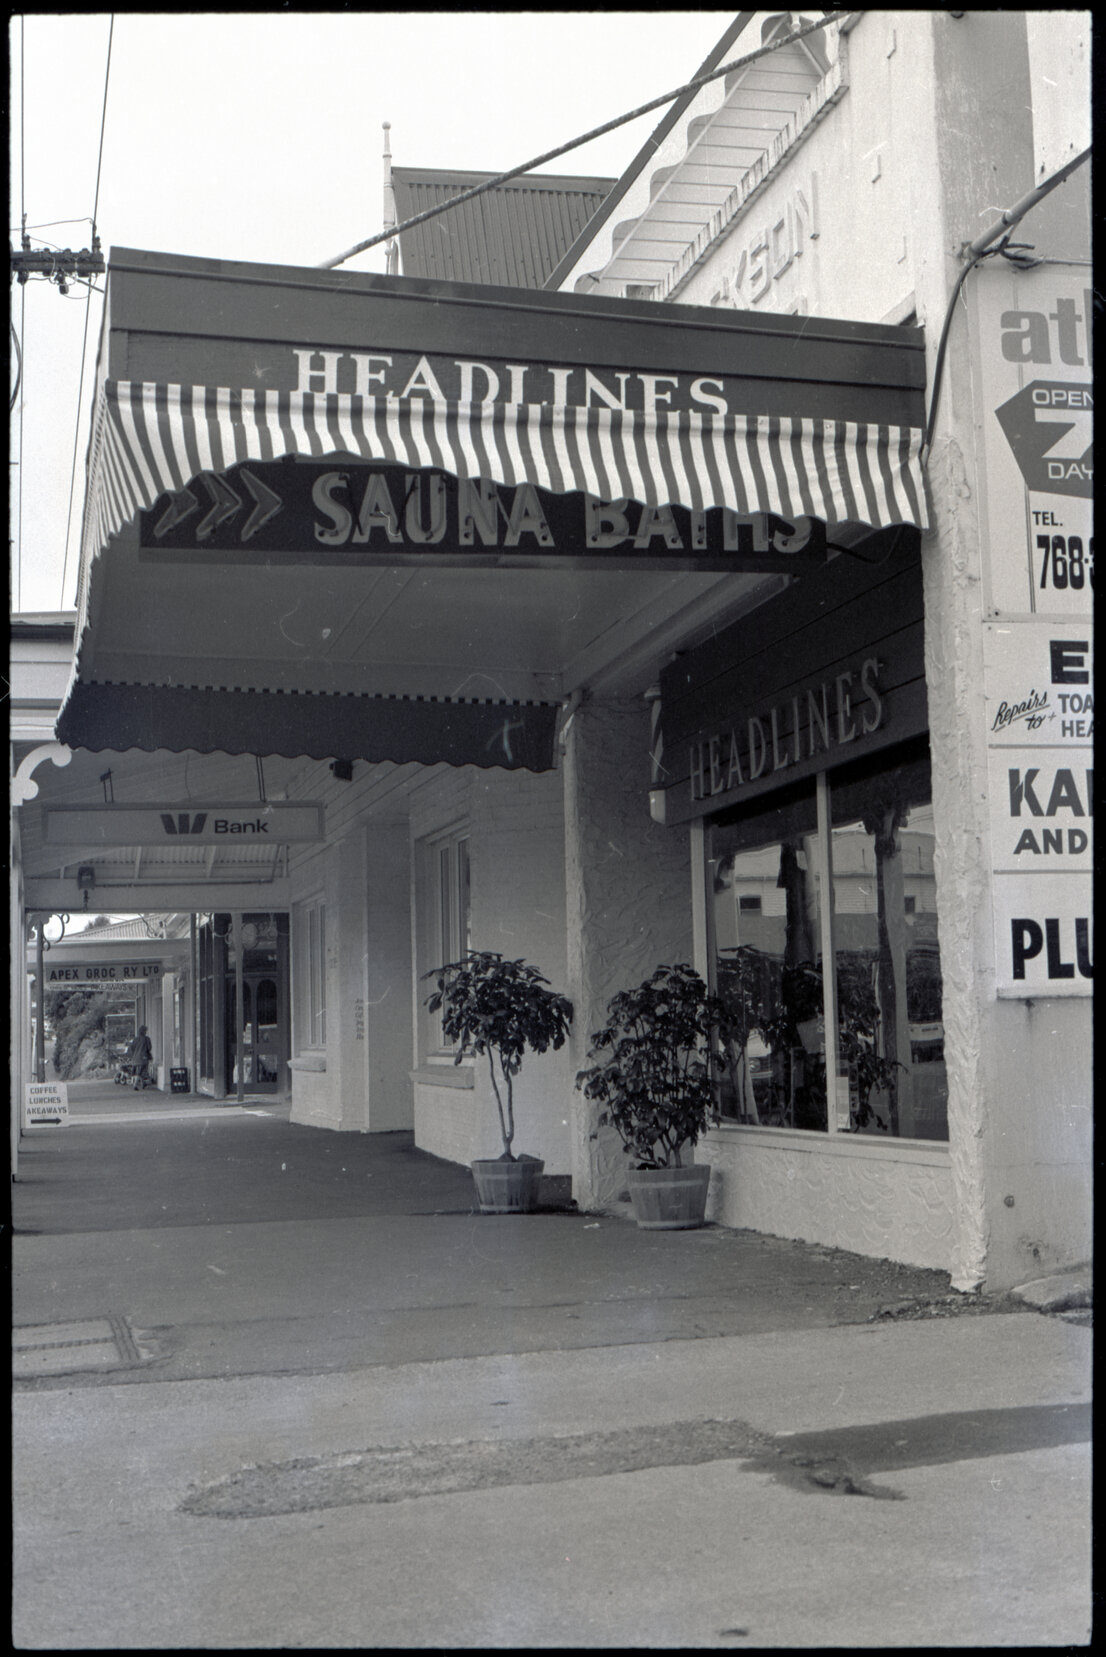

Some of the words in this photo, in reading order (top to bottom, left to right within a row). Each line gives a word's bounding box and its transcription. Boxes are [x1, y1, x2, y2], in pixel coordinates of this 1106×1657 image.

[292, 349, 729, 415] HEADLINES
[1032, 388, 1093, 406] OPEN
[1034, 407, 1093, 460] 7
[311, 472, 556, 548] SAUNA
[1032, 511, 1064, 527] TEL.
[990, 688, 1048, 731] Repairs
[689, 657, 882, 801] HEADLINES
[1024, 714, 1046, 731] to
[214, 819, 269, 834] Bank
[1013, 829, 1088, 855] AND
[50, 968, 79, 981] APEX
[30, 1086, 58, 1094] COFFEE
[29, 1096, 62, 1104] LUNCHES
